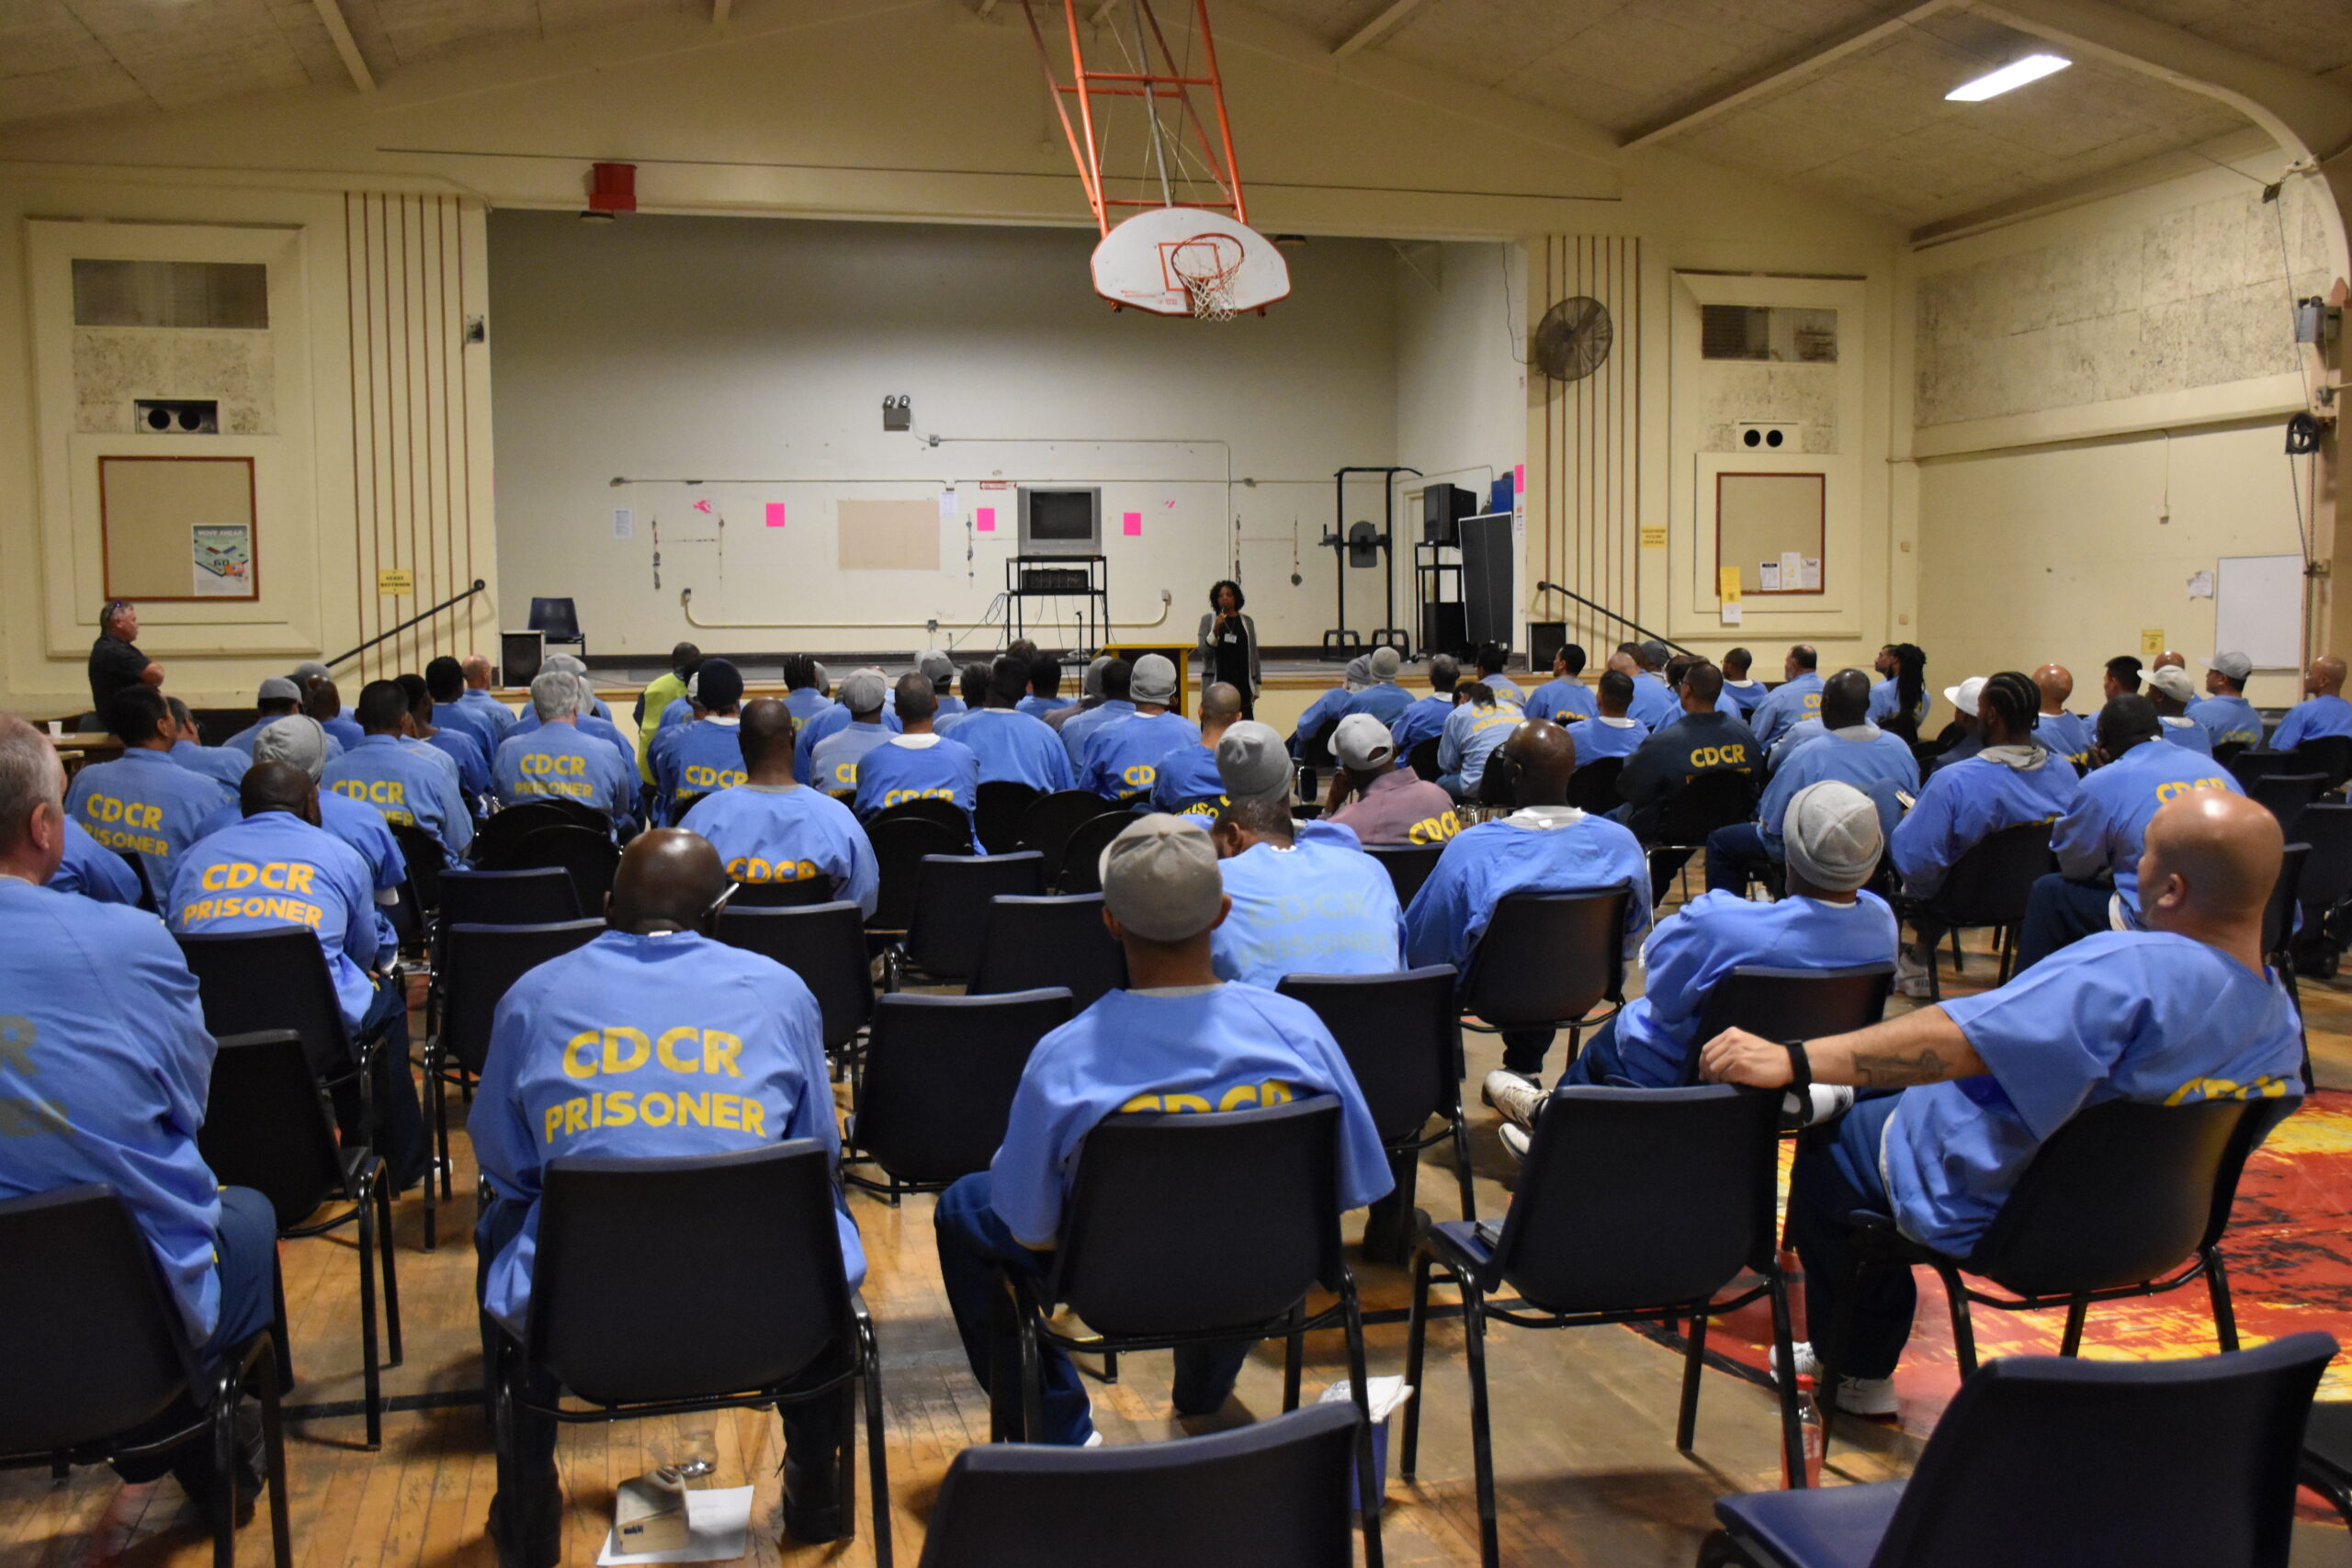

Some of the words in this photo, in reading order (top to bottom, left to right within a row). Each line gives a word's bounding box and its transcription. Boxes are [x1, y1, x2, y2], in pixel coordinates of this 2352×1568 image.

[1803, 694, 1823, 708] CD
[520, 754, 585, 776] CDCR
[1690, 744, 1747, 768] CDCR
[684, 765, 749, 789] CDCR
[1124, 765, 1156, 785] CD
[332, 779, 405, 806] CDCR
[514, 781, 594, 797] PRISONER
[86, 793, 163, 831] CDCR
[202, 863, 315, 895] CDCR
[183, 897, 323, 930] PRISONER
[1246, 892, 1369, 929] CDCR
[562, 1026, 747, 1079] CDCR
[545, 1090, 767, 1144] PRISONER
